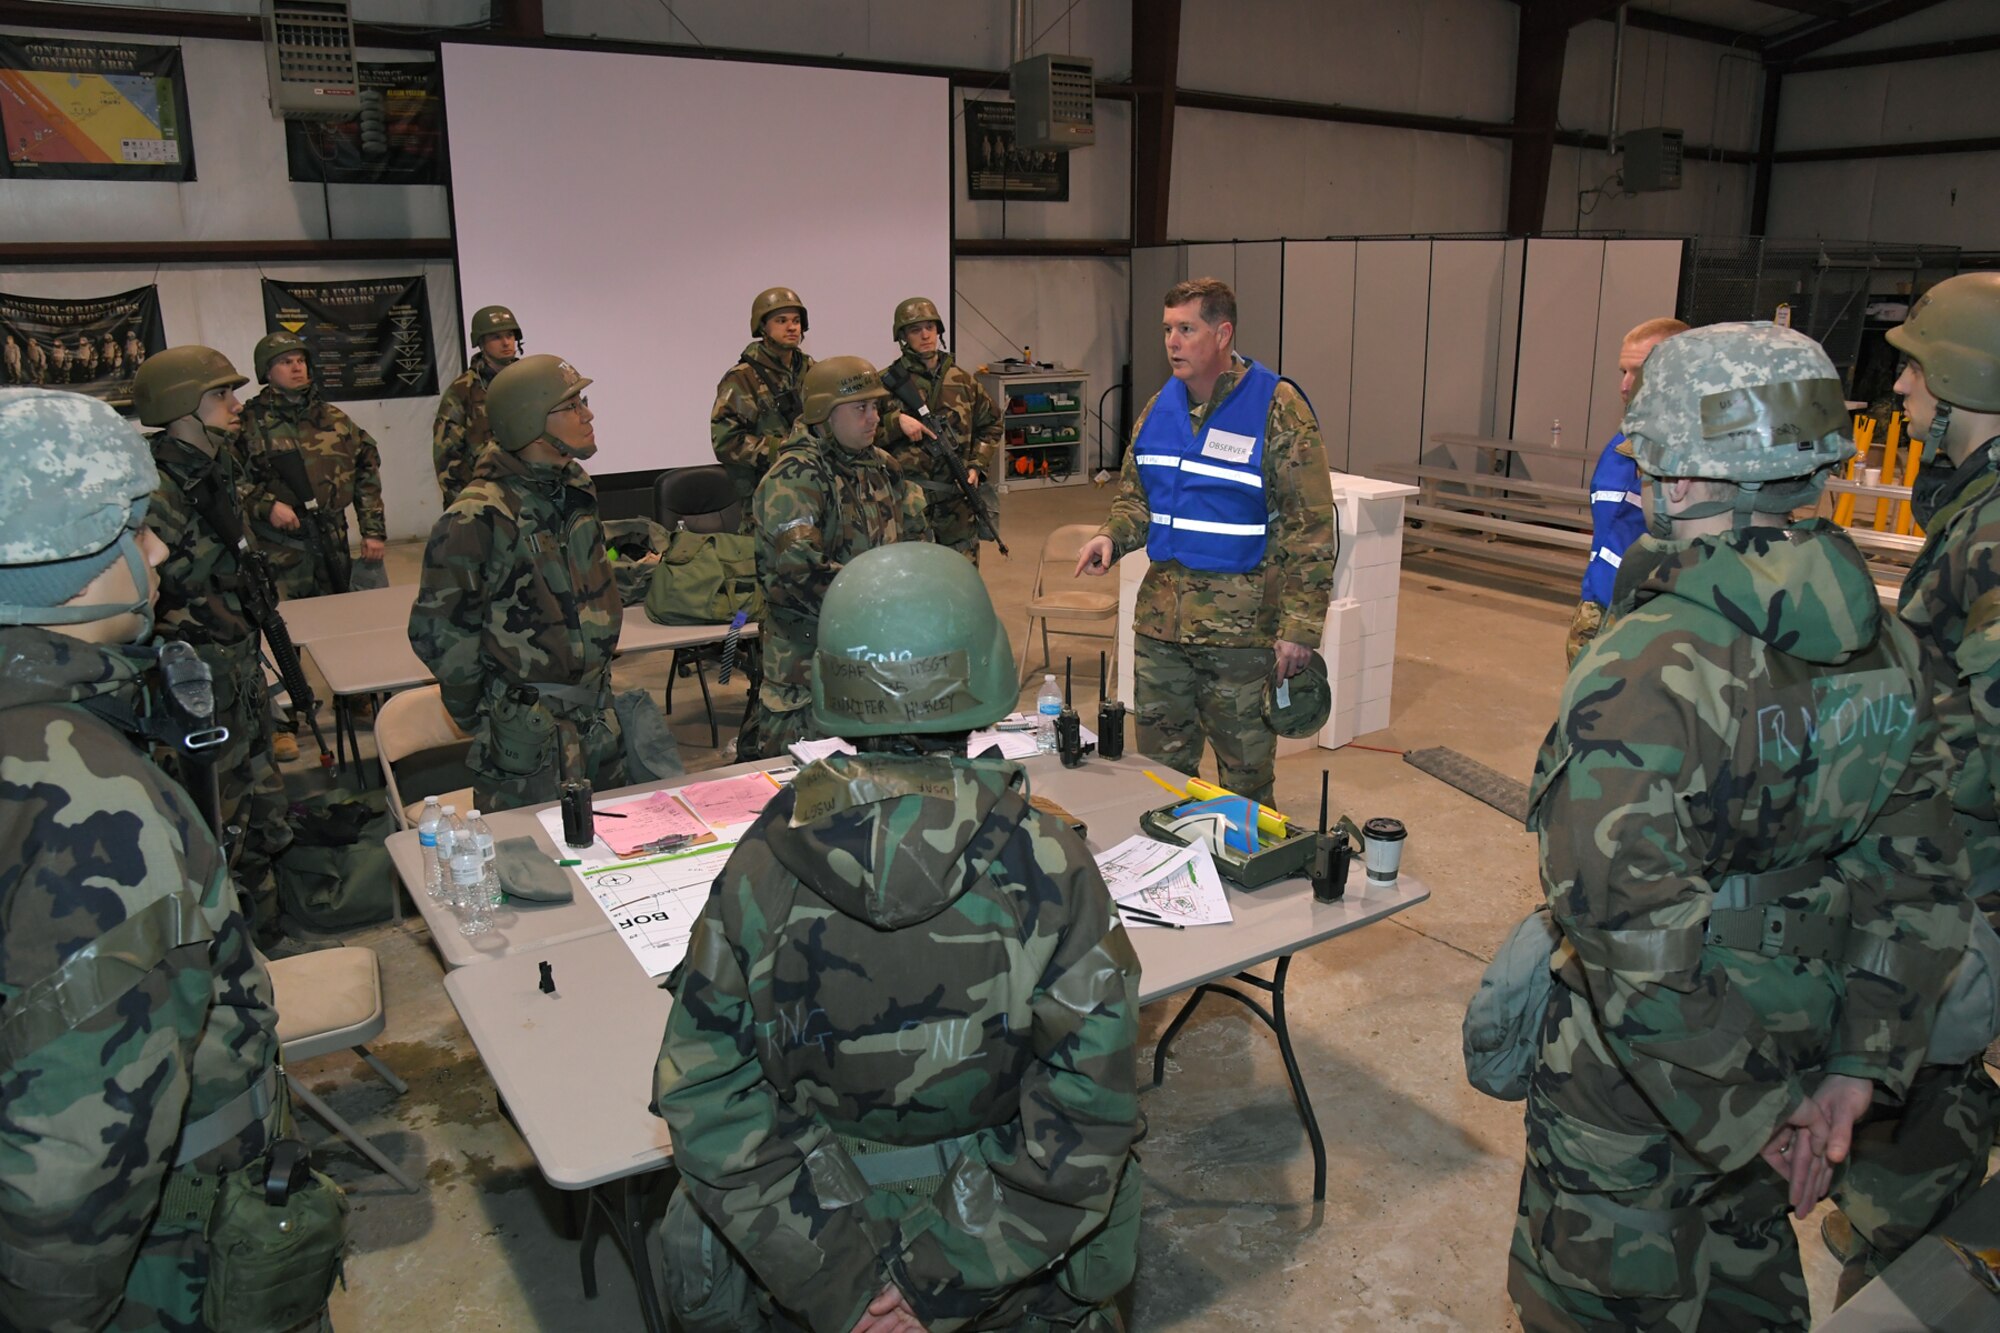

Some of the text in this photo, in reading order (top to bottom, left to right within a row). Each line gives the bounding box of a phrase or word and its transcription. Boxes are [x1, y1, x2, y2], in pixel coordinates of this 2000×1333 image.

[25, 44, 137, 61] CONTAMINATION
[31, 56, 135, 71] CONTROL AREA
[359, 284, 405, 296] HAZARD
[319, 294, 376, 305] MARKERS
[1208, 441, 1247, 455] OBSERVER
[505, 748, 520, 760] US
[917, 784, 949, 795] USAF
